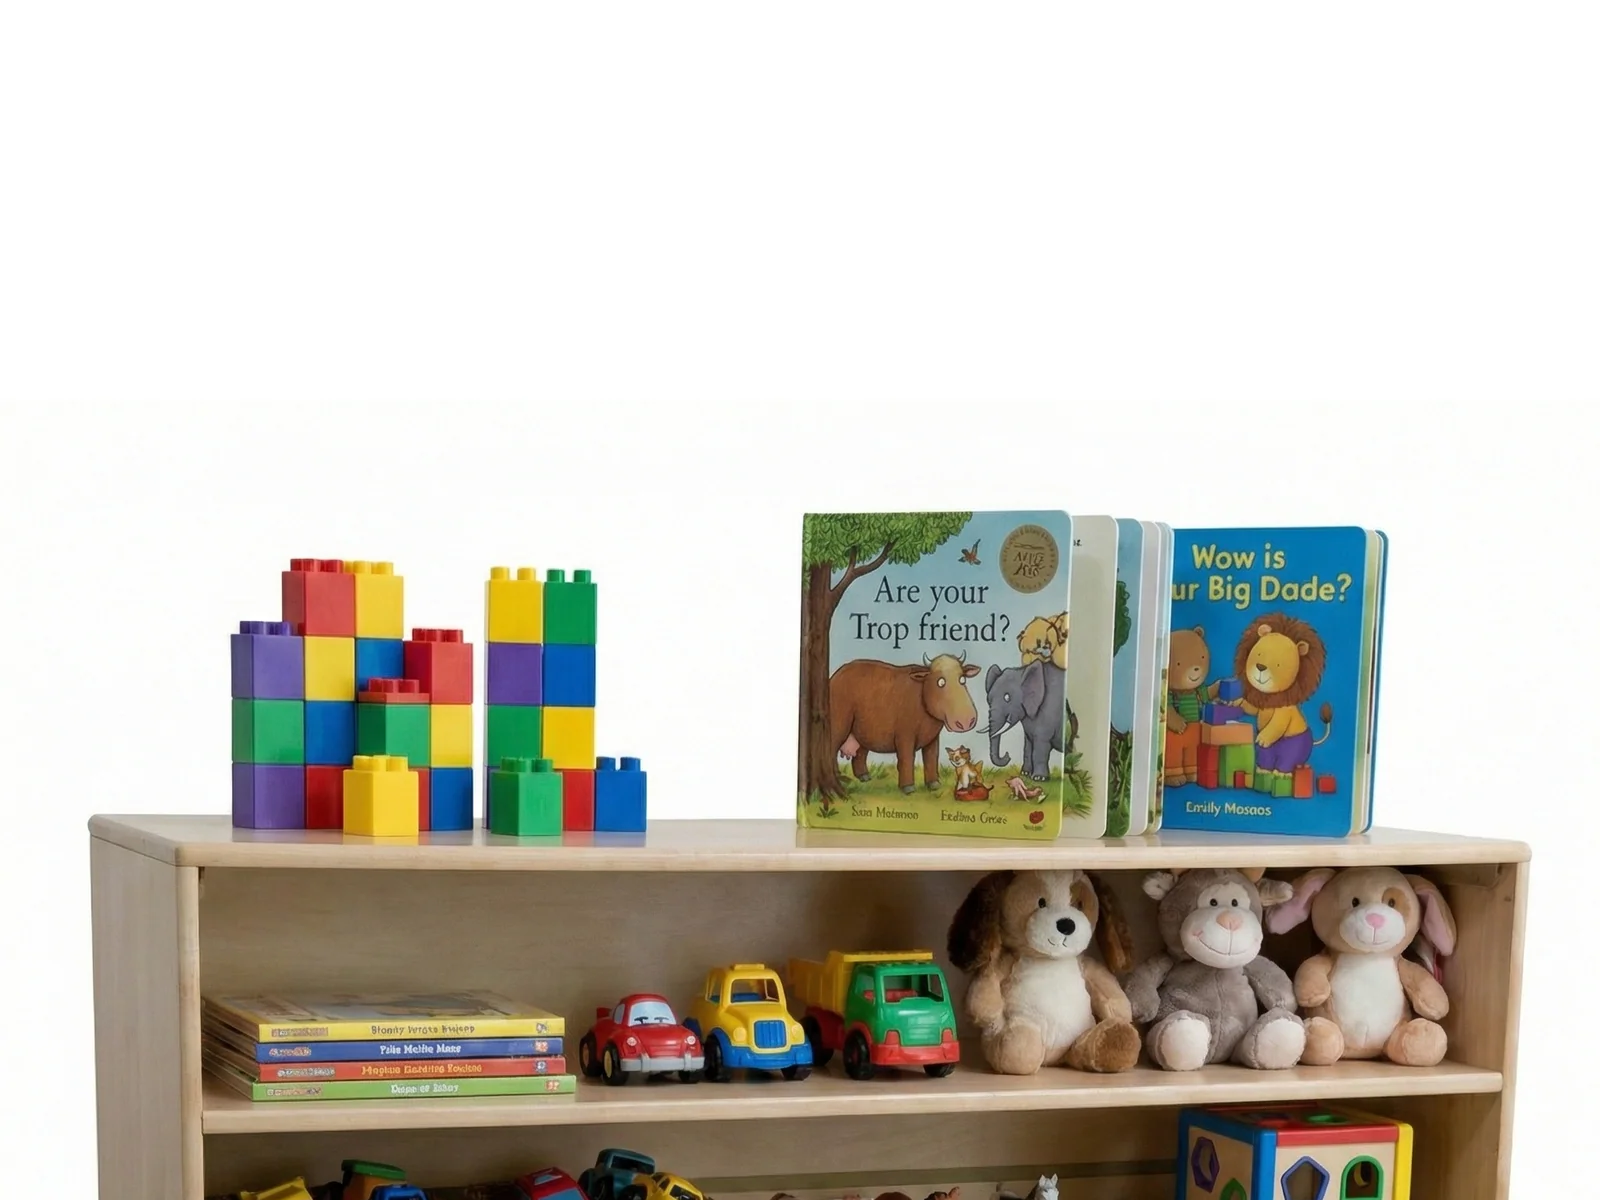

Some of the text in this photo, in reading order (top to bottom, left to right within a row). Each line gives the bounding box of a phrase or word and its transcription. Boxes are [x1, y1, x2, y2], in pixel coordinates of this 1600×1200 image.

[1191, 542, 1285, 569] Wow is
[873, 575, 989, 612] Are your
[1208, 575, 1251, 610] Big
[1260, 573, 1352, 602] Dade?
[849, 612, 1010, 649] Trop friend?
